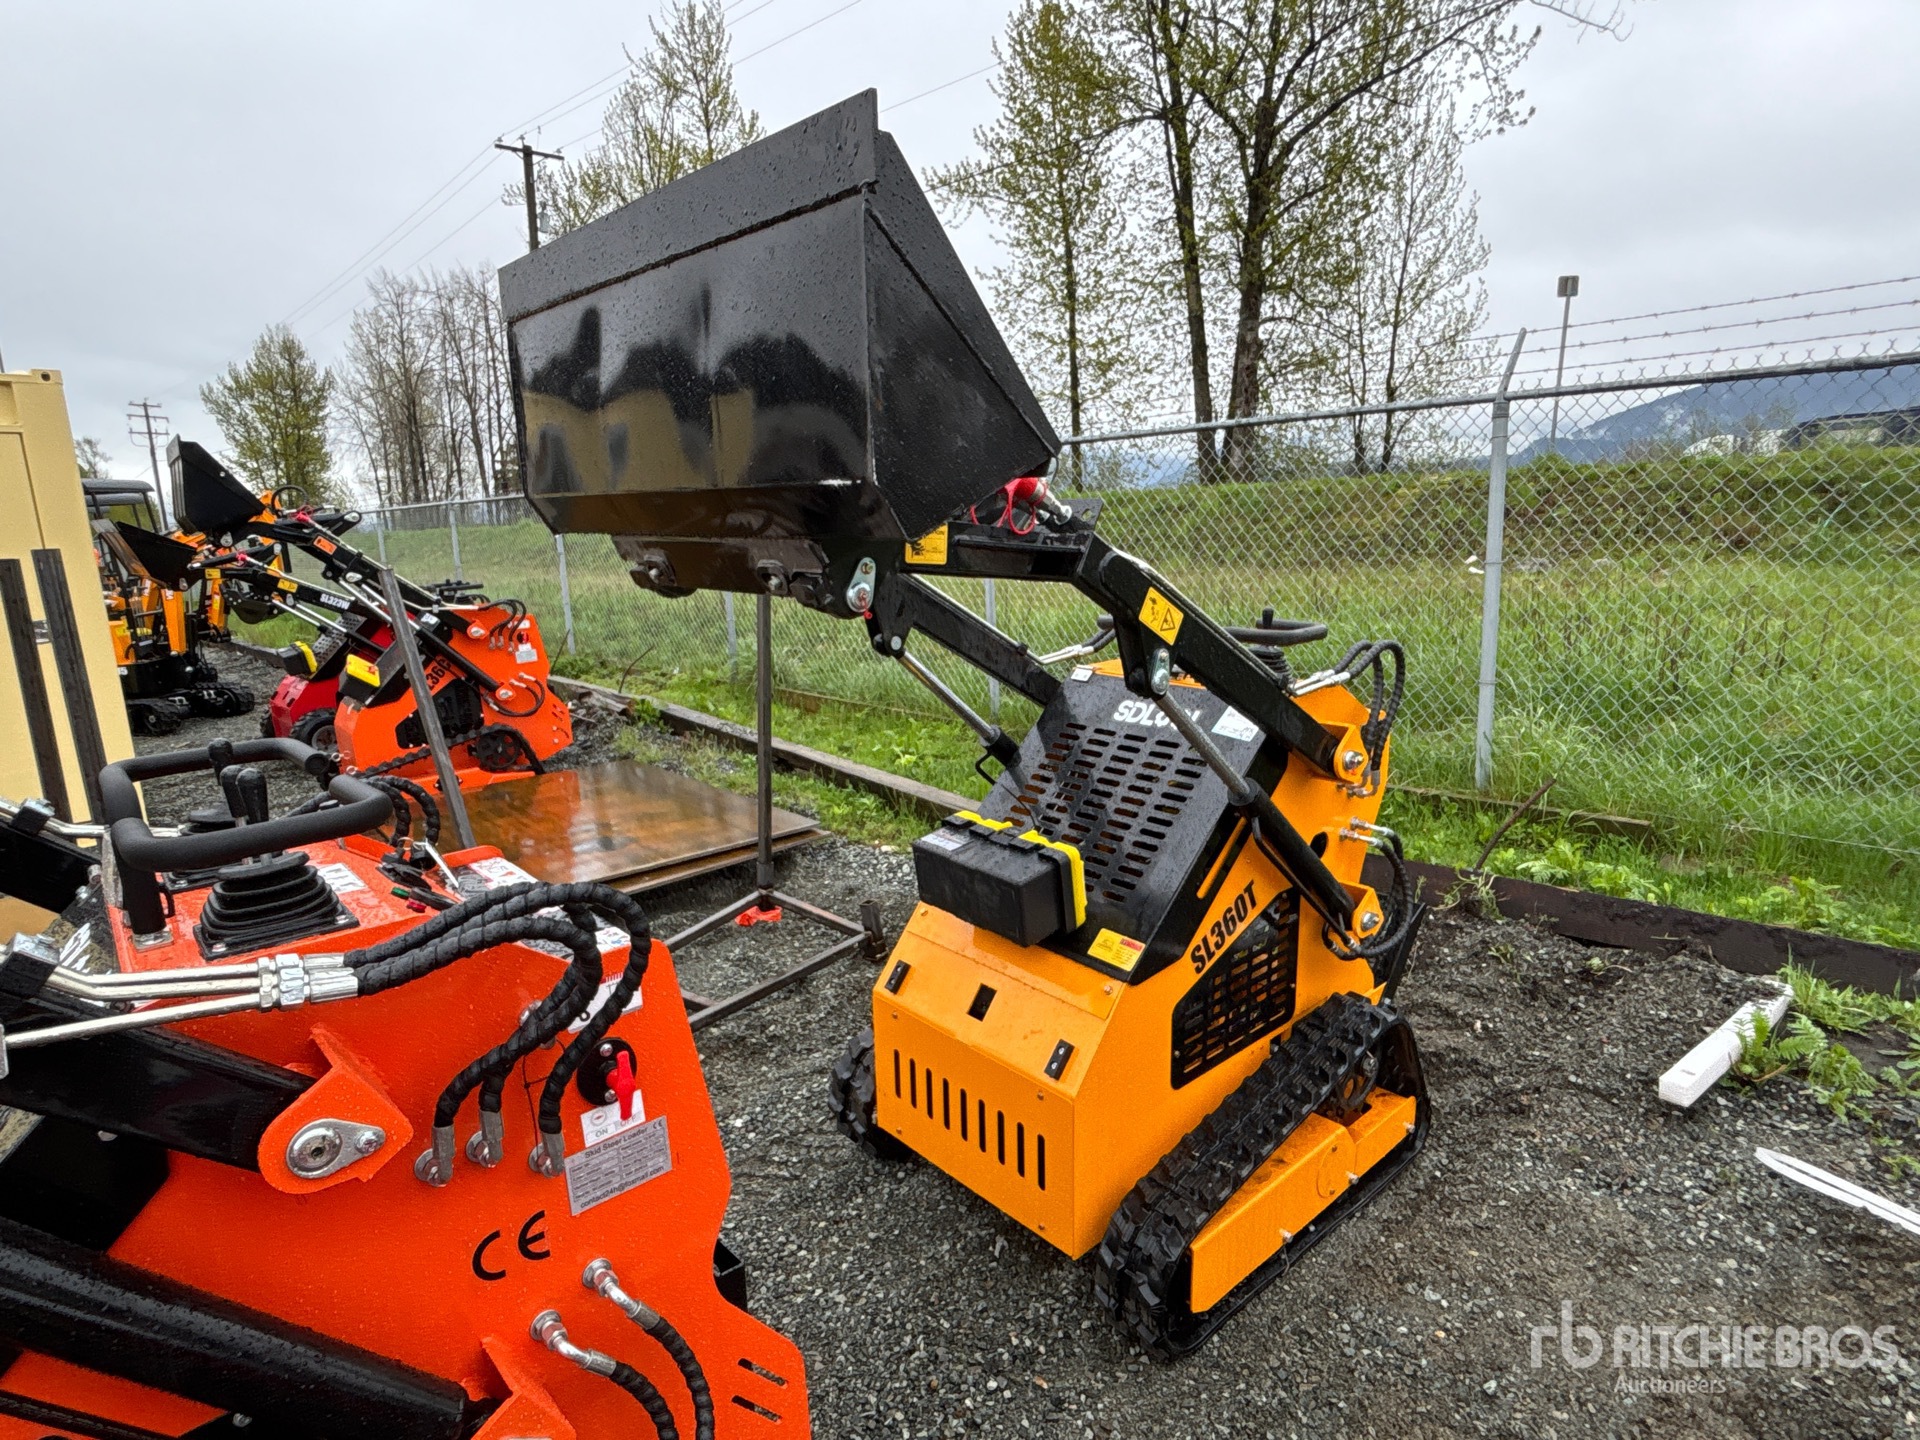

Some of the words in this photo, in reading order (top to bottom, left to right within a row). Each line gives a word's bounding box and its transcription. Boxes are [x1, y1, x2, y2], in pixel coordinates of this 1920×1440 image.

[1190, 879, 1257, 974] SL360T
[585, 1146, 602, 1159] Skid
[602, 1138, 622, 1151] Steer
[623, 1127, 648, 1142] Loader
[595, 1128, 609, 1138] ON
[472, 1210, 551, 1281] CE
